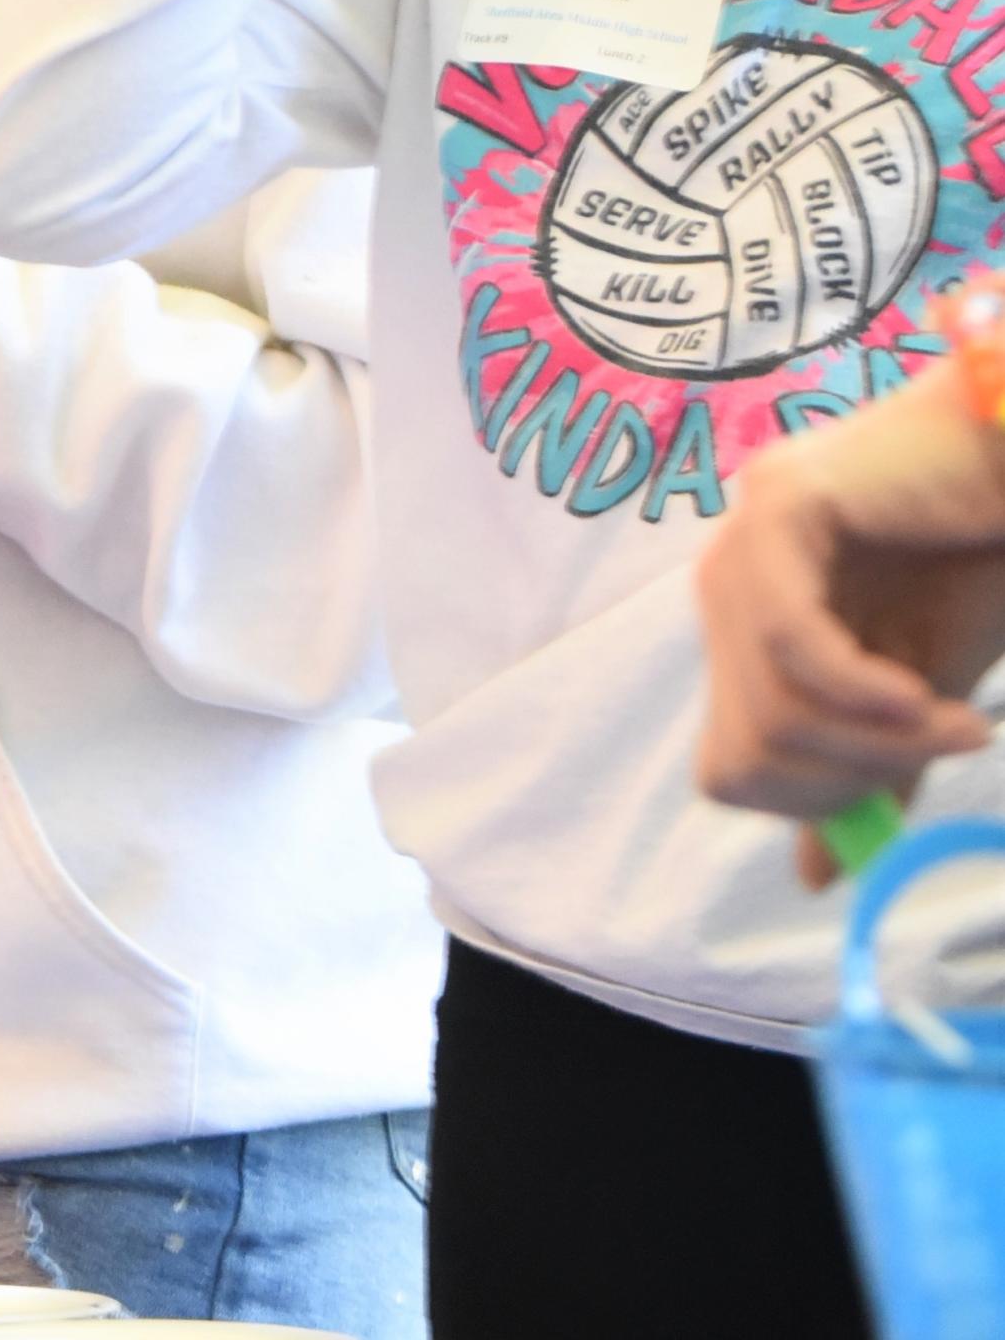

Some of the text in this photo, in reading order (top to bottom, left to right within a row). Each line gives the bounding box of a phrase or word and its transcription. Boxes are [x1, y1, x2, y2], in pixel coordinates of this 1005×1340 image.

[619, 89, 653, 134] ACE
[717, 79, 836, 192] RALLY
[575, 190, 708, 247] SERVE
[803, 179, 857, 301] BLOCK
[459, 282, 726, 523] KINDA
